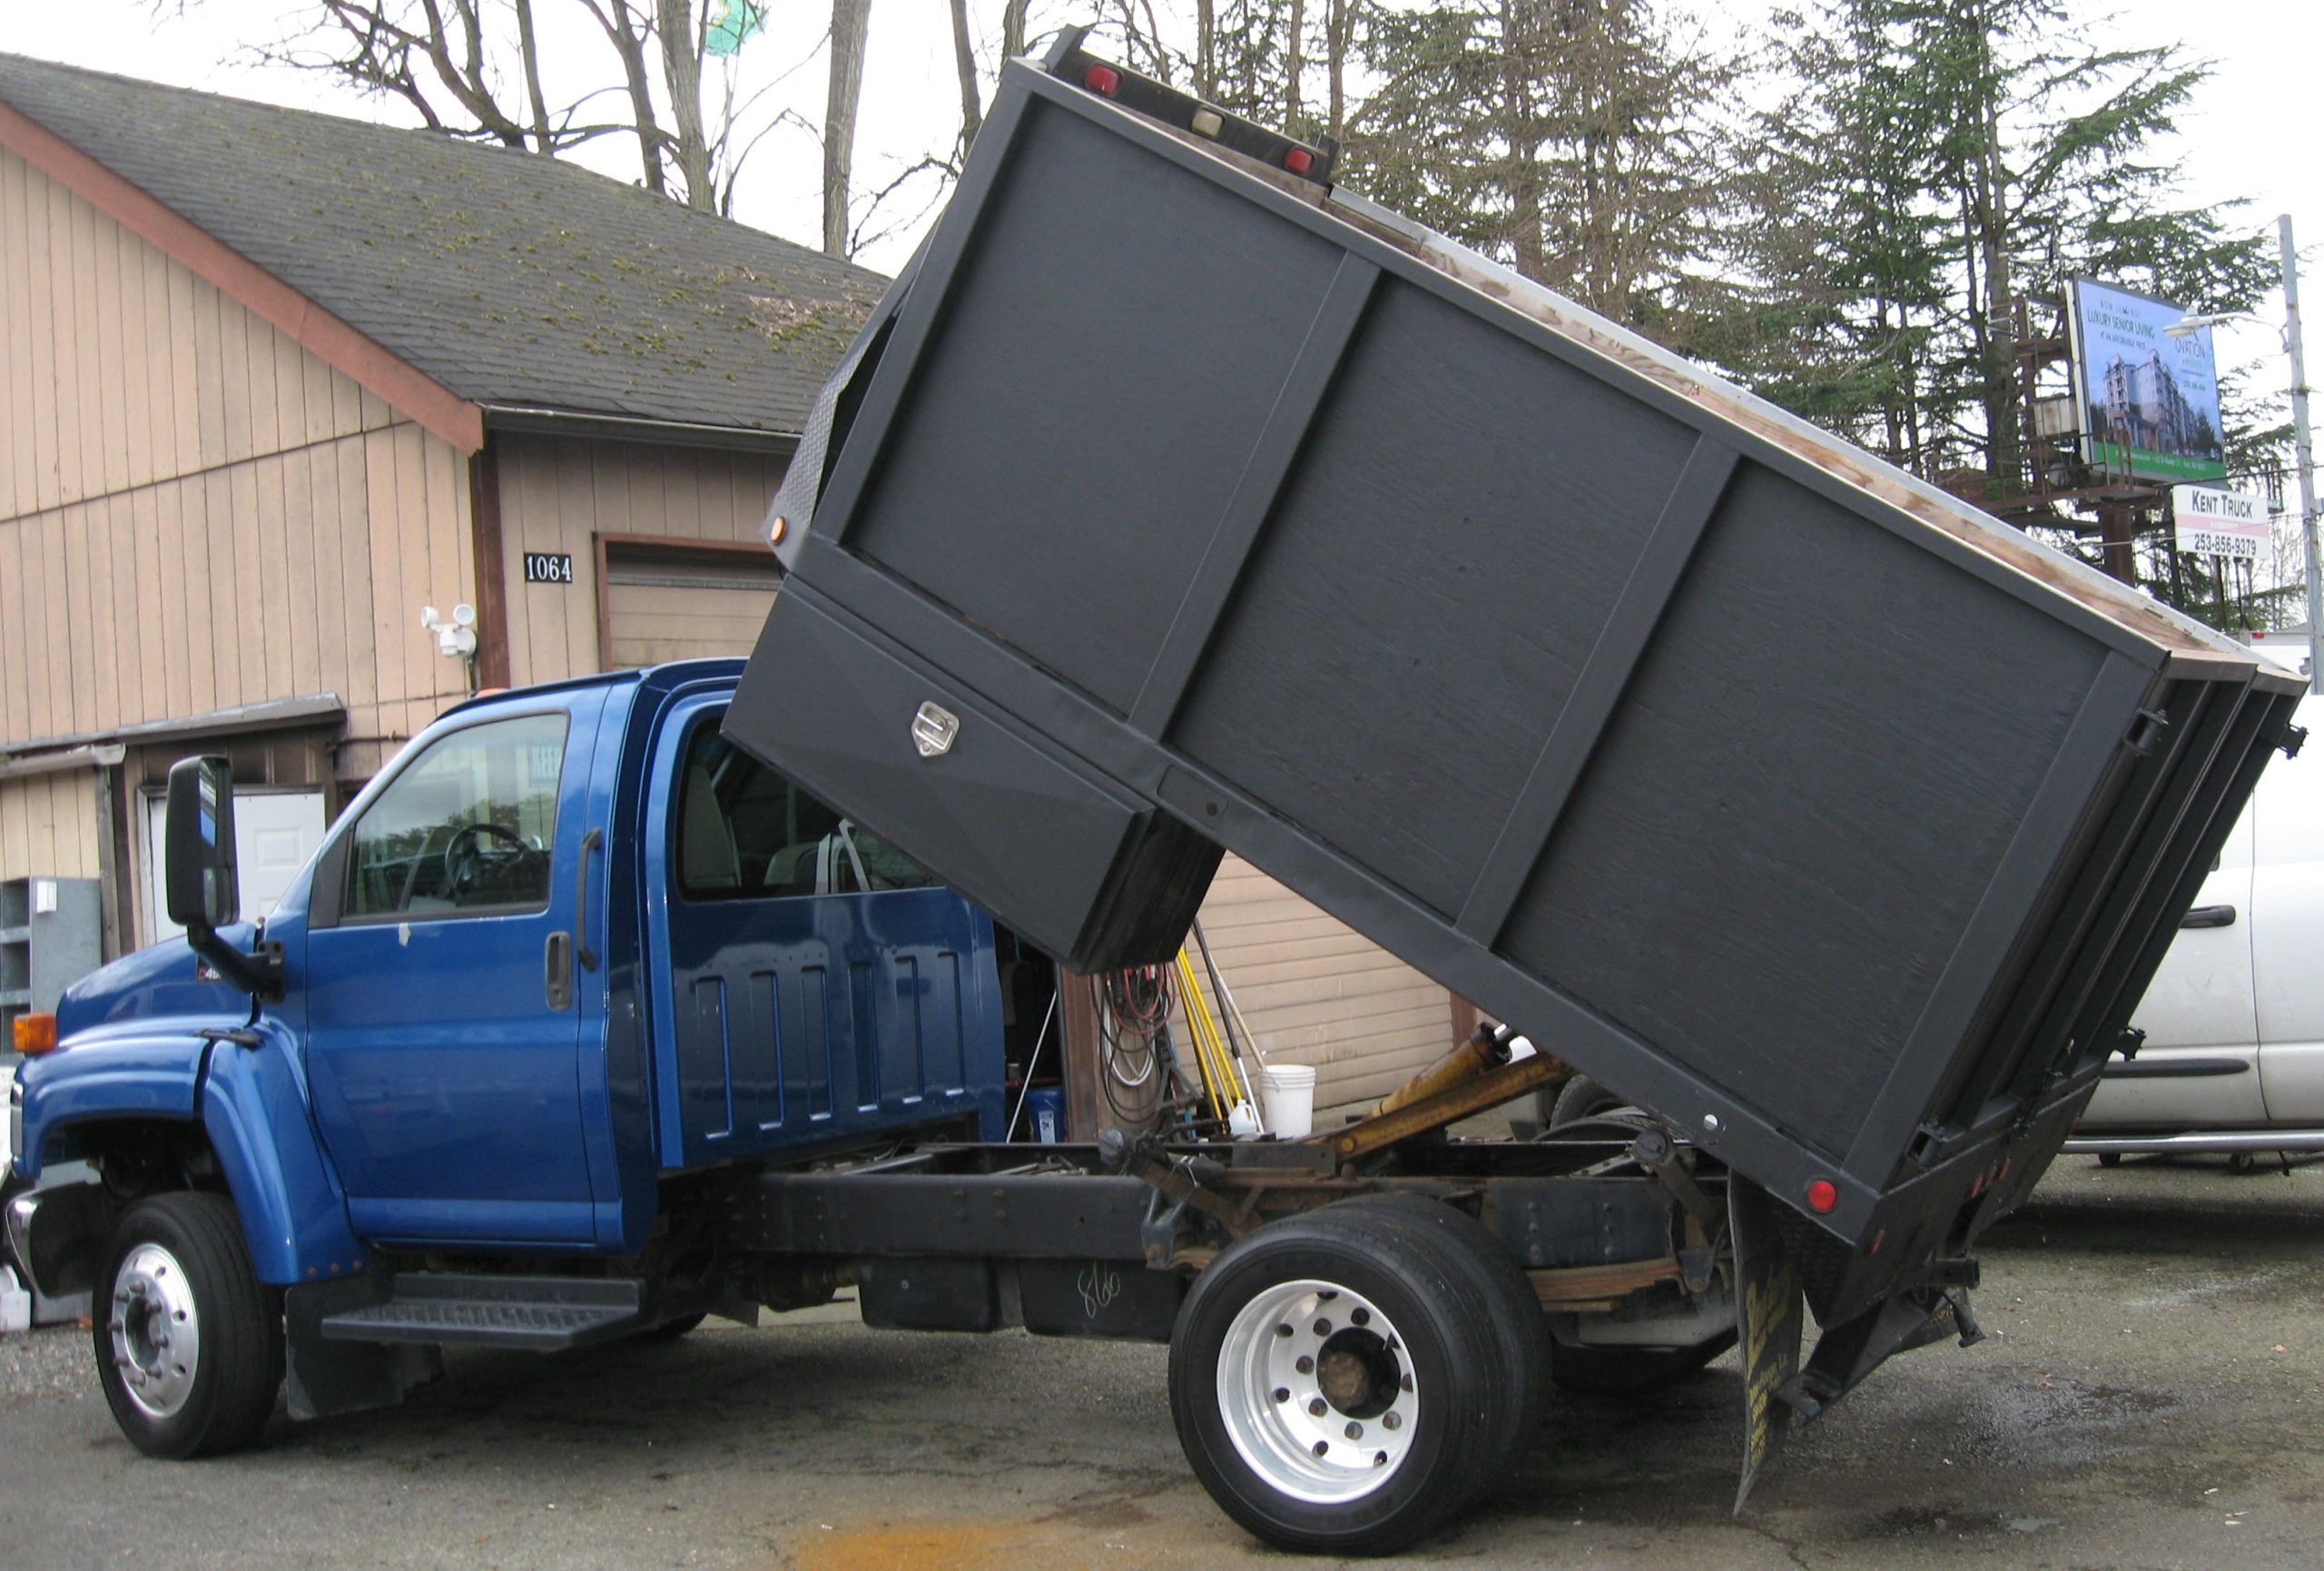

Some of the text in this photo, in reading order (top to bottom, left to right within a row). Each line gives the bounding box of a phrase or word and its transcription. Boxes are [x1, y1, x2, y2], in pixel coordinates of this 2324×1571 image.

[2087, 309, 2155, 340] LUXURY SENIOR LIVING
[2175, 336, 2206, 359] OVATION
[2194, 533, 2257, 557] 253-856-9379
[527, 555, 572, 582] 1064
